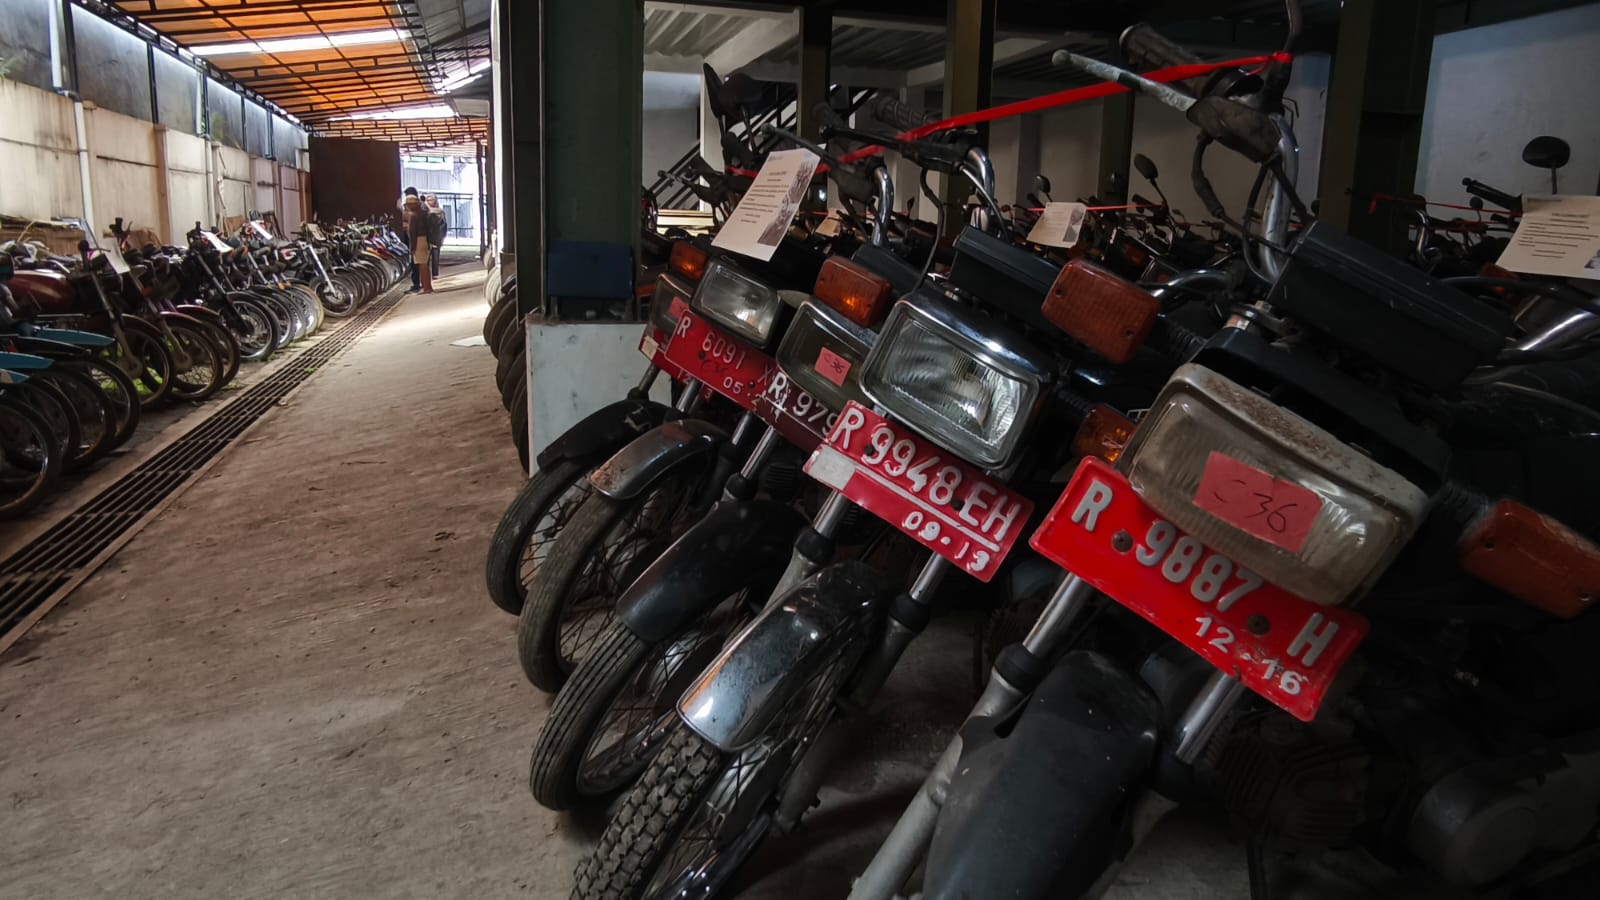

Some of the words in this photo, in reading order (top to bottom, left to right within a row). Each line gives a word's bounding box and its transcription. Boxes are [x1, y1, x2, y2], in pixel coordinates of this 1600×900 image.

[677, 316, 691, 338] R
[702, 331, 746, 370] 6091
[768, 372, 787, 399] R
[831, 408, 864, 450] R
[861, 424, 963, 506] 9948
[959, 482, 1021, 541] EH
[1071, 480, 1113, 532] R
[1135, 520, 1264, 613] 9887
[1286, 611, 1340, 667] H
